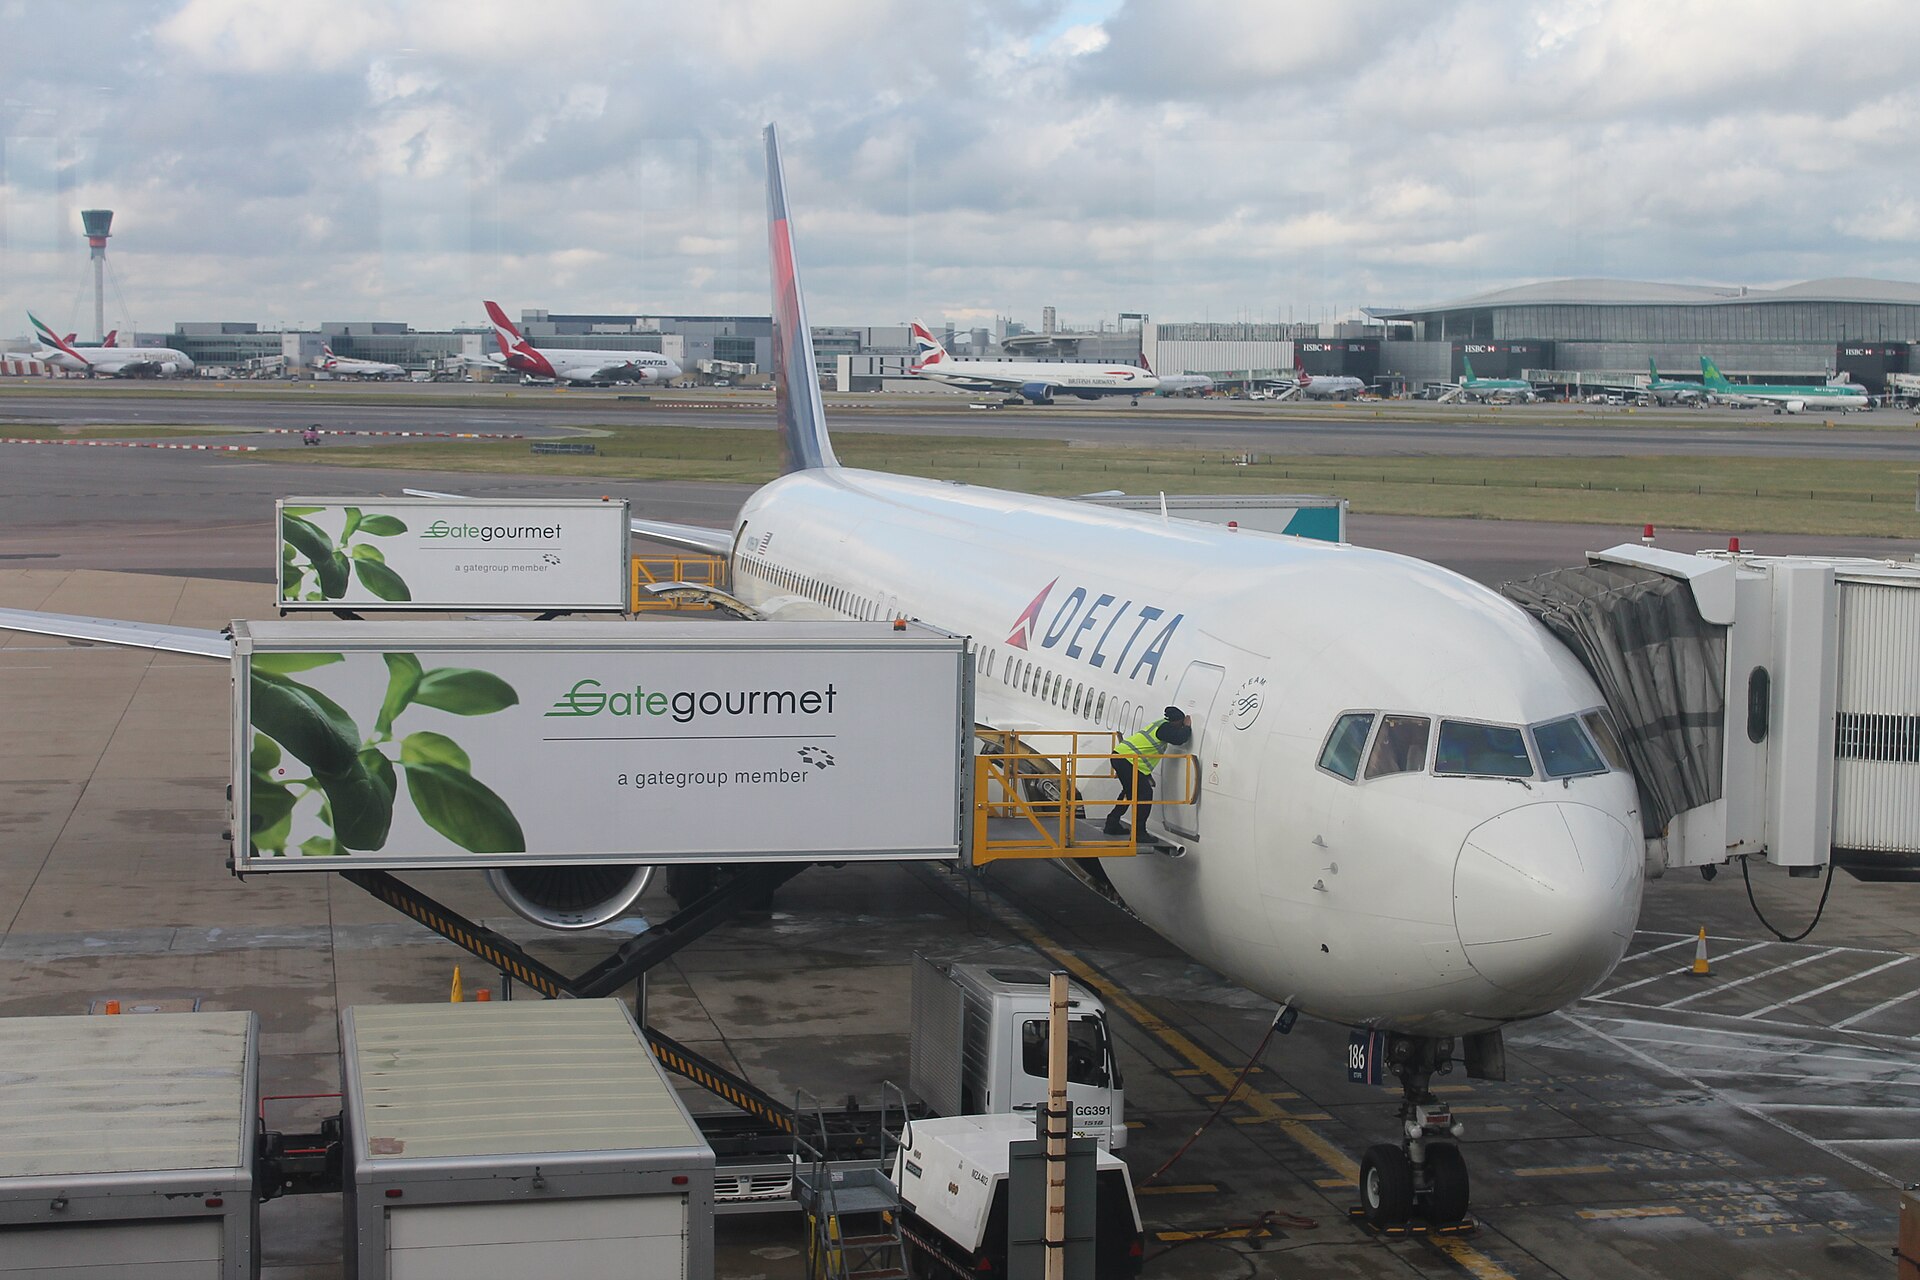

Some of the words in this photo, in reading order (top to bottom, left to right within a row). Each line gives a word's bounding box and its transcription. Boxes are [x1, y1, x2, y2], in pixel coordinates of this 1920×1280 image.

[1845, 348, 1864, 356] HSBC
[420, 520, 562, 542] Gategourmet
[463, 564, 509, 573] gategroup
[511, 564, 548, 572] member
[1041, 586, 1184, 686] DELTA
[543, 679, 837, 723] Gategourmet
[617, 773, 628, 785] a
[635, 769, 728, 789] gategroup
[735, 768, 809, 784] member
[1348, 1044, 1365, 1069] 186
[1075, 1106, 1110, 1116] GG391
